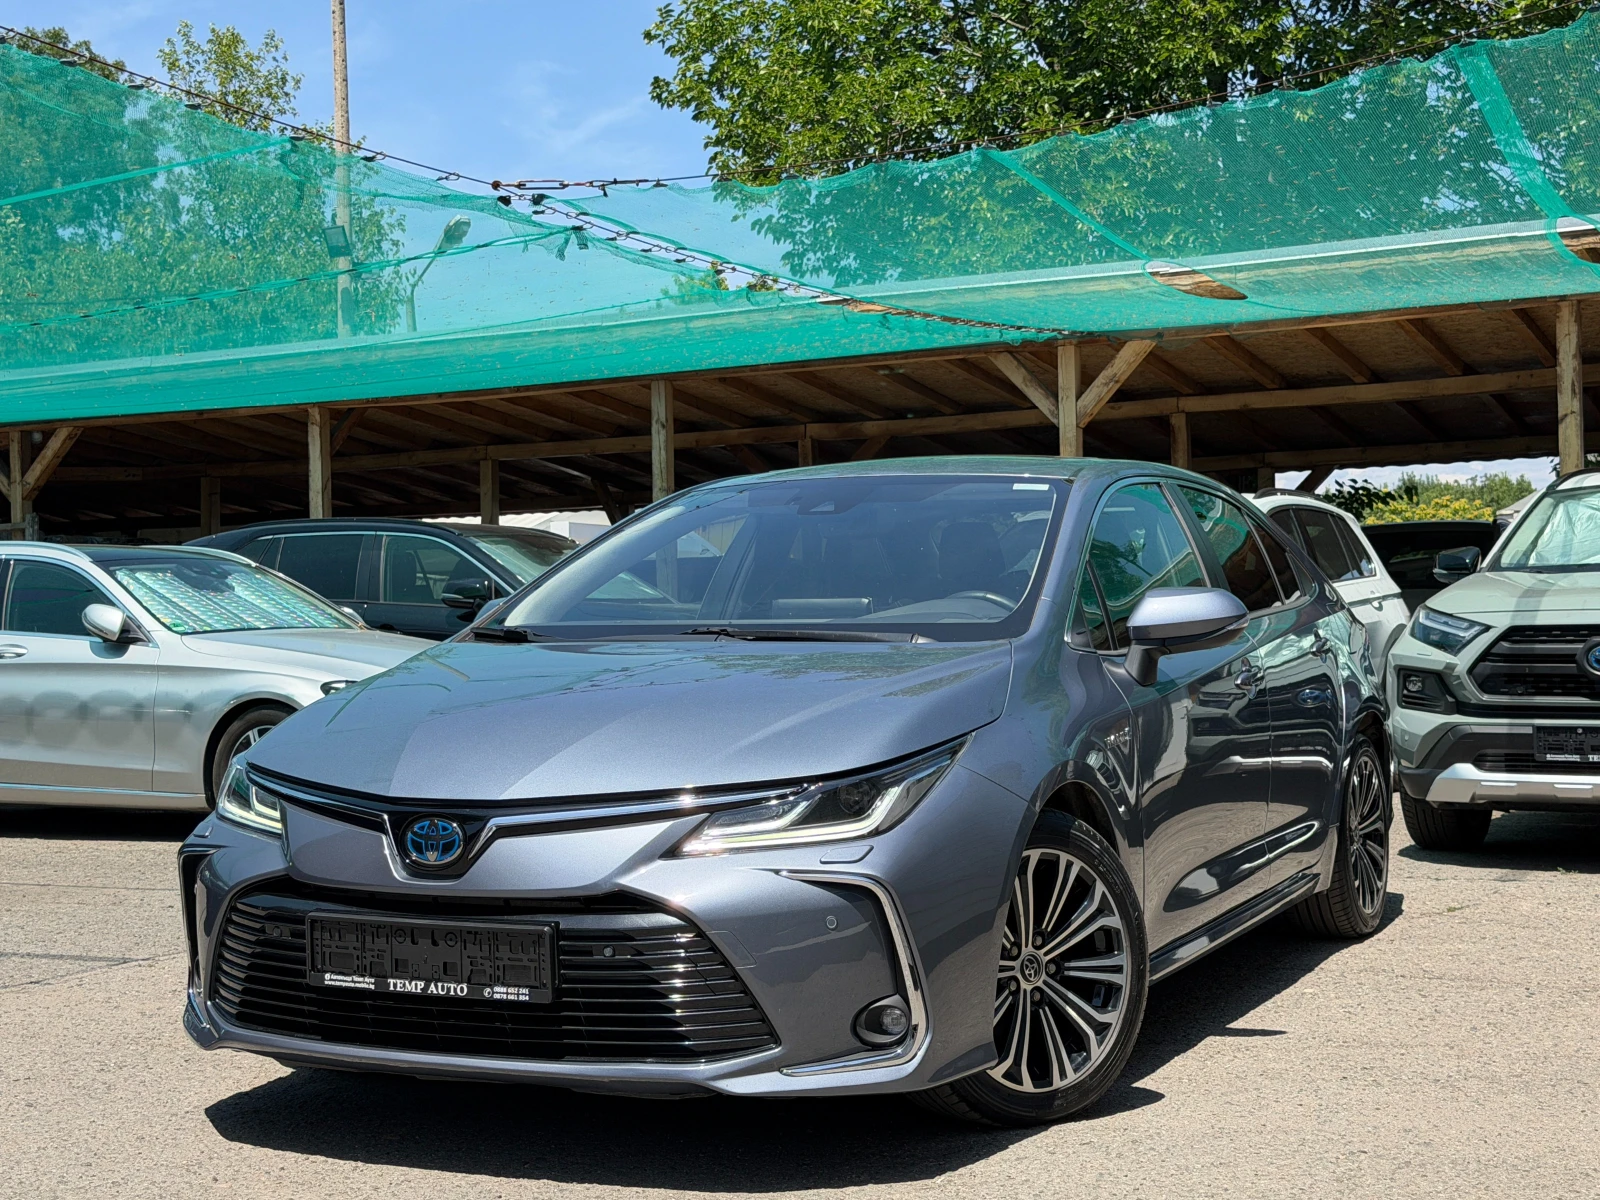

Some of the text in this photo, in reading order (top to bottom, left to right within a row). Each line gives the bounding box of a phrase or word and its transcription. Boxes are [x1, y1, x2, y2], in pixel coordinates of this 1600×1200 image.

[1587, 754, 1600, 762] TE
[387, 978, 468, 996] TEMP AUTO
